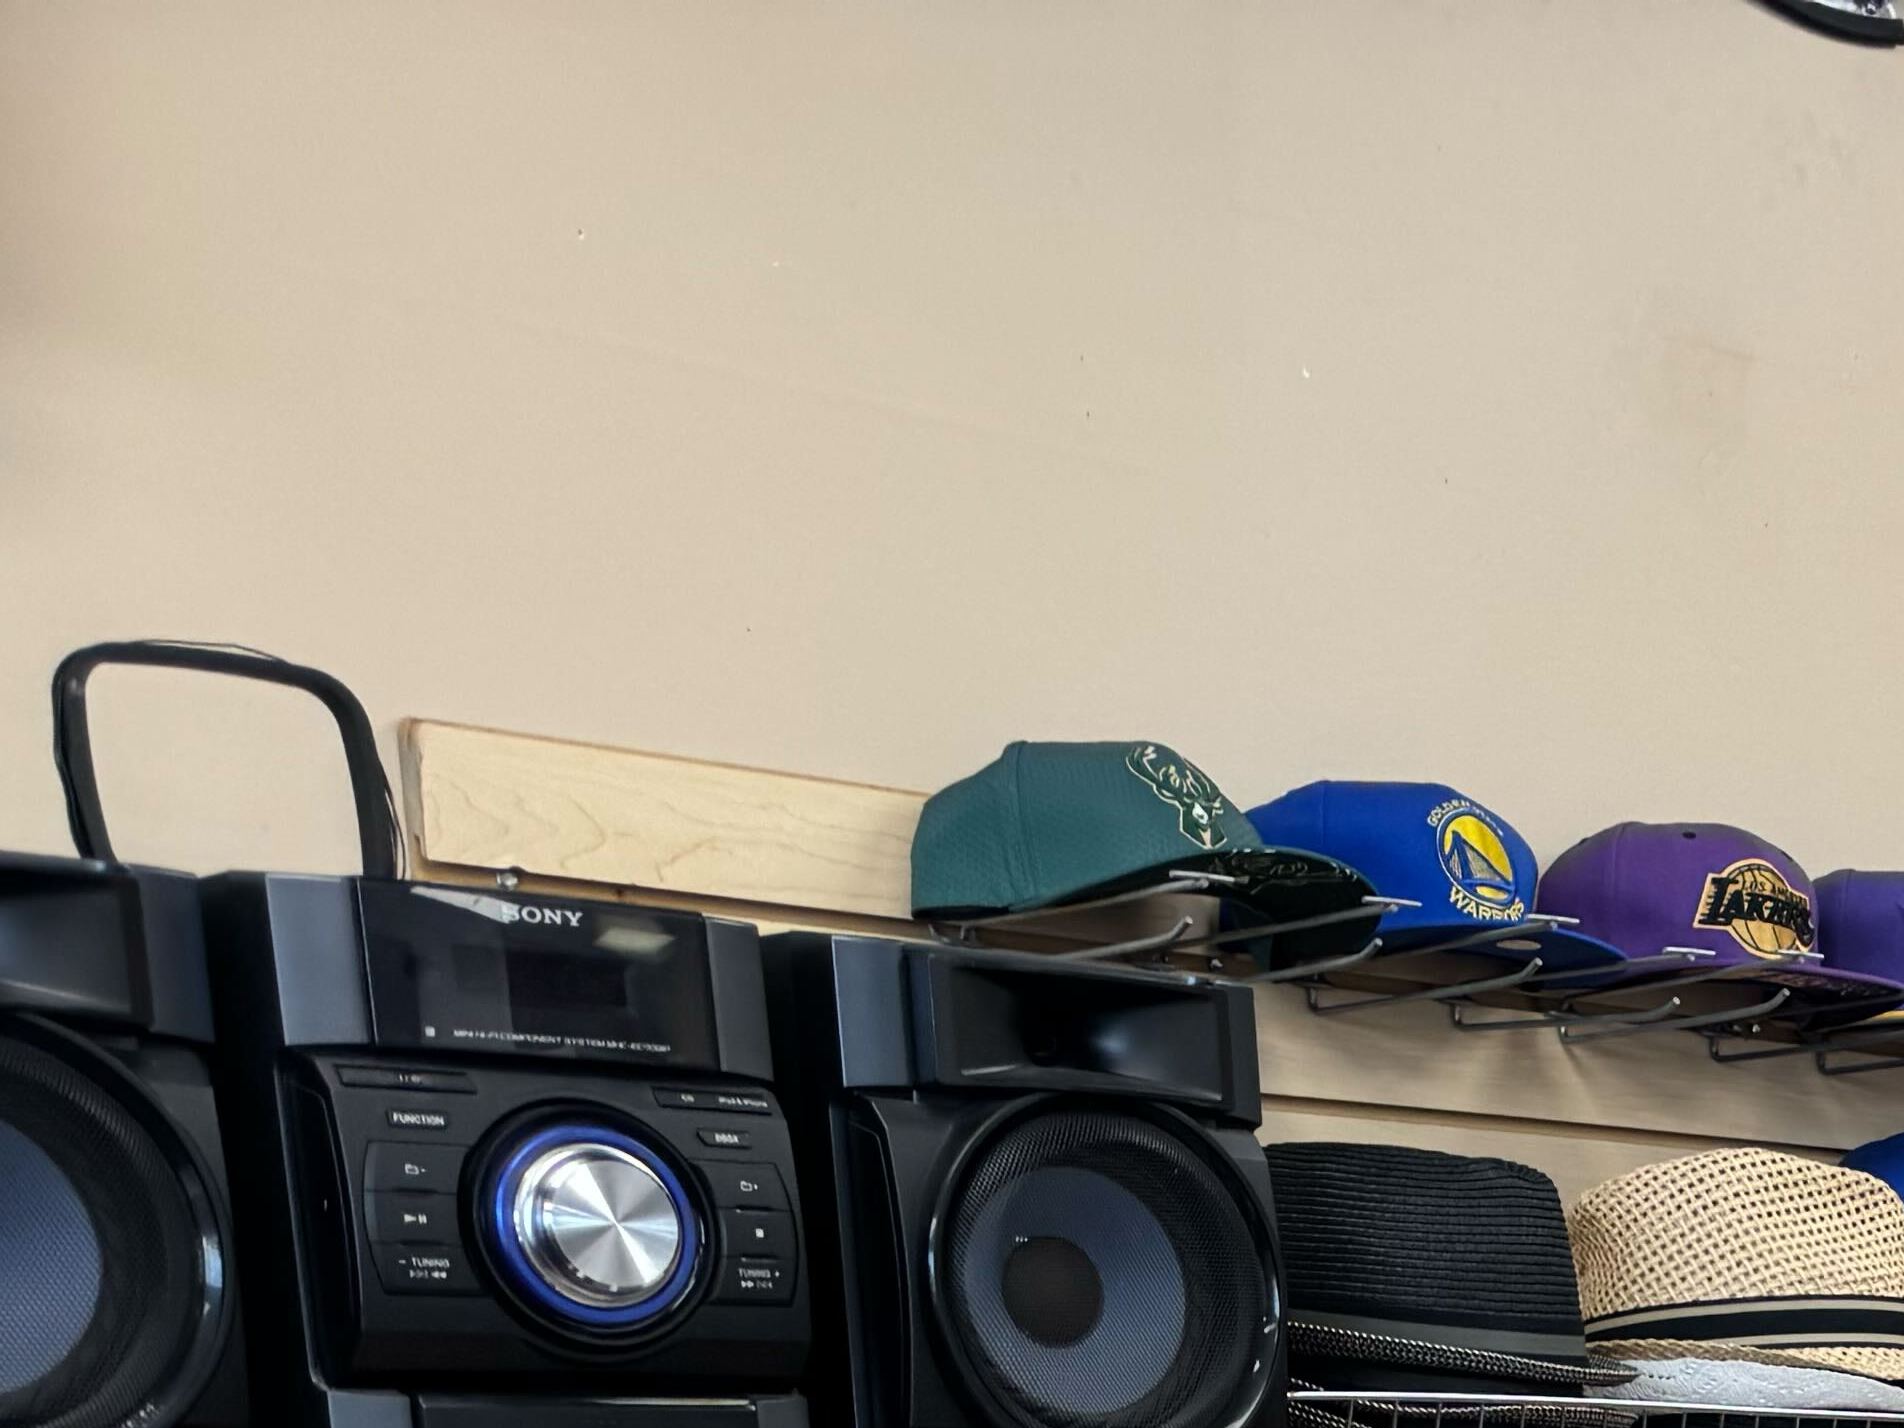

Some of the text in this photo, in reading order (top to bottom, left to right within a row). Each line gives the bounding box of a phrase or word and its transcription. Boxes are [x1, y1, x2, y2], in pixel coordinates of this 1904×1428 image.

[502, 907, 583, 926] SONY
[1700, 877, 1814, 946] LAKERS
[393, 1111, 445, 1126] FUNCTION
[413, 1257, 450, 1268] TUNING
